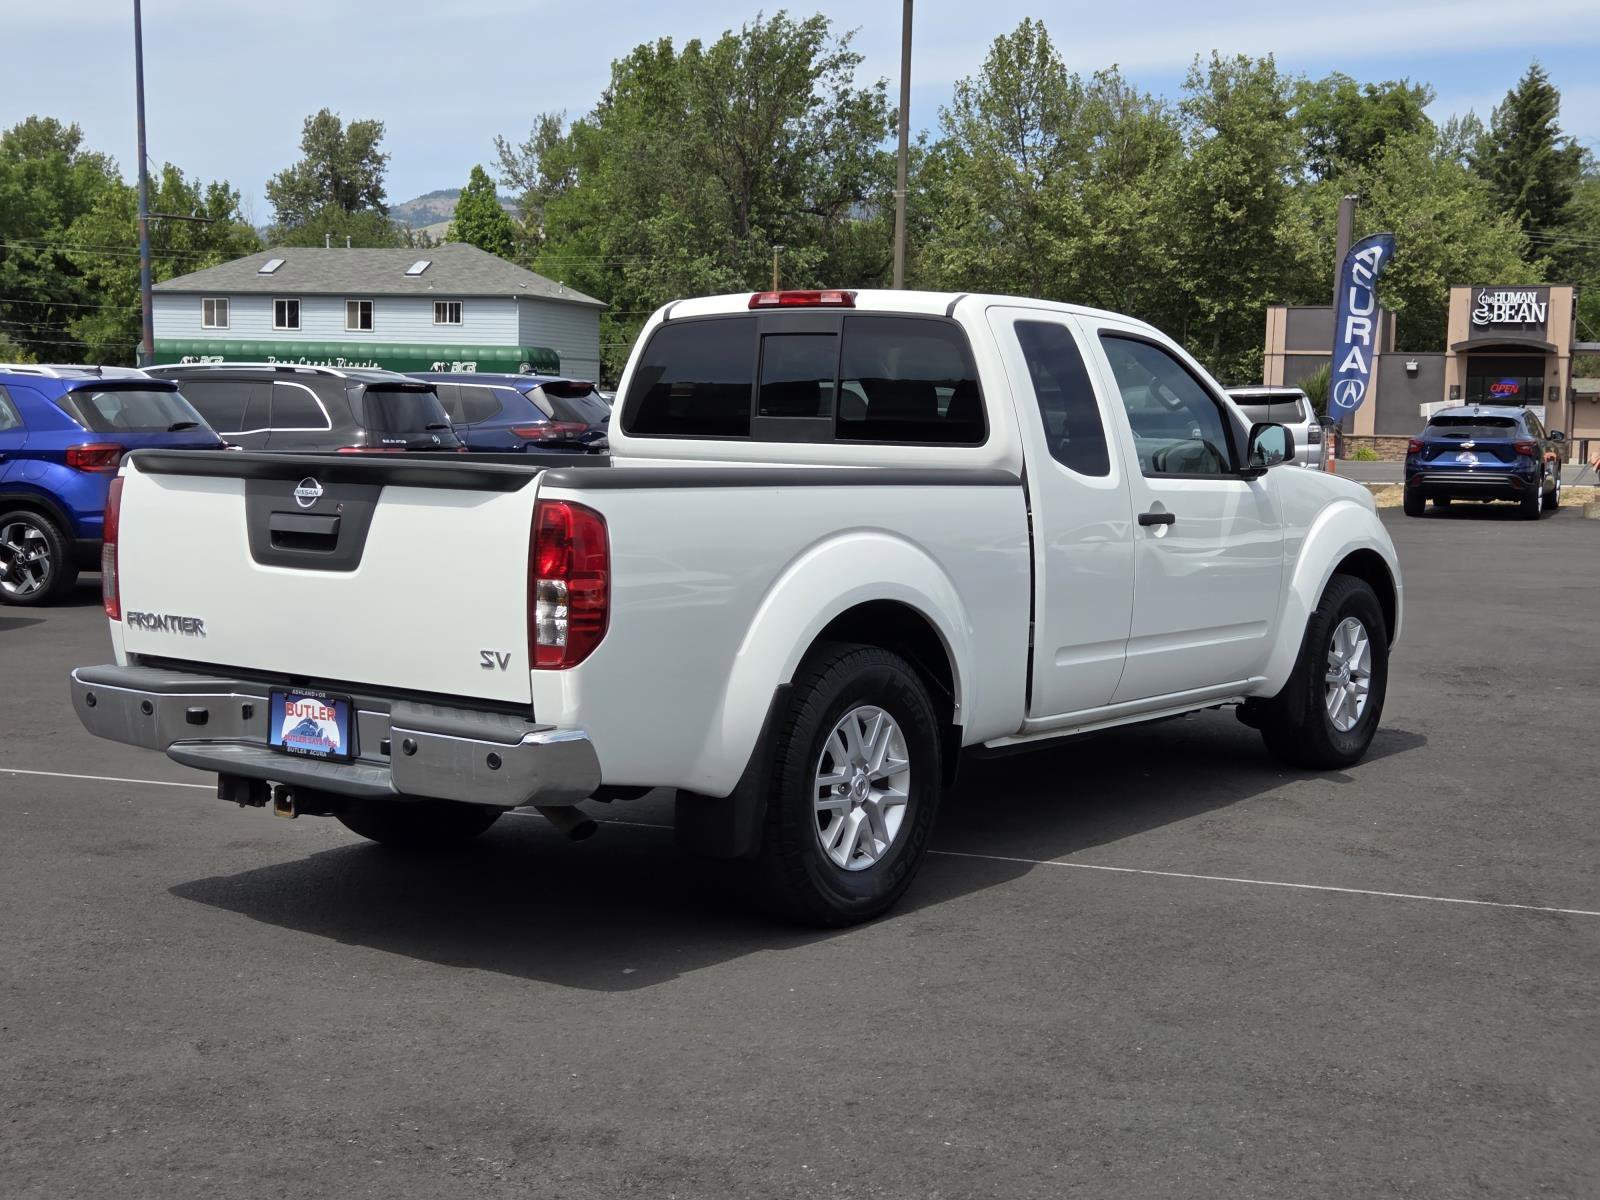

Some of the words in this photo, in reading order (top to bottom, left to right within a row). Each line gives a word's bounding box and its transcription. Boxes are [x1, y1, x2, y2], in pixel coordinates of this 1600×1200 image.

[1481, 295, 1495, 304] the
[1494, 291, 1538, 304] HUMAN
[1338, 245, 1384, 375] ACURA
[1491, 302, 1547, 323] BEAN
[1490, 383, 1519, 394] OPEN
[126, 611, 207, 638] FRONTIER
[480, 650, 511, 672] SV
[285, 702, 336, 721] BUTLER
[287, 747, 307, 755] BUTLER
[309, 749, 327, 757] ACURA
